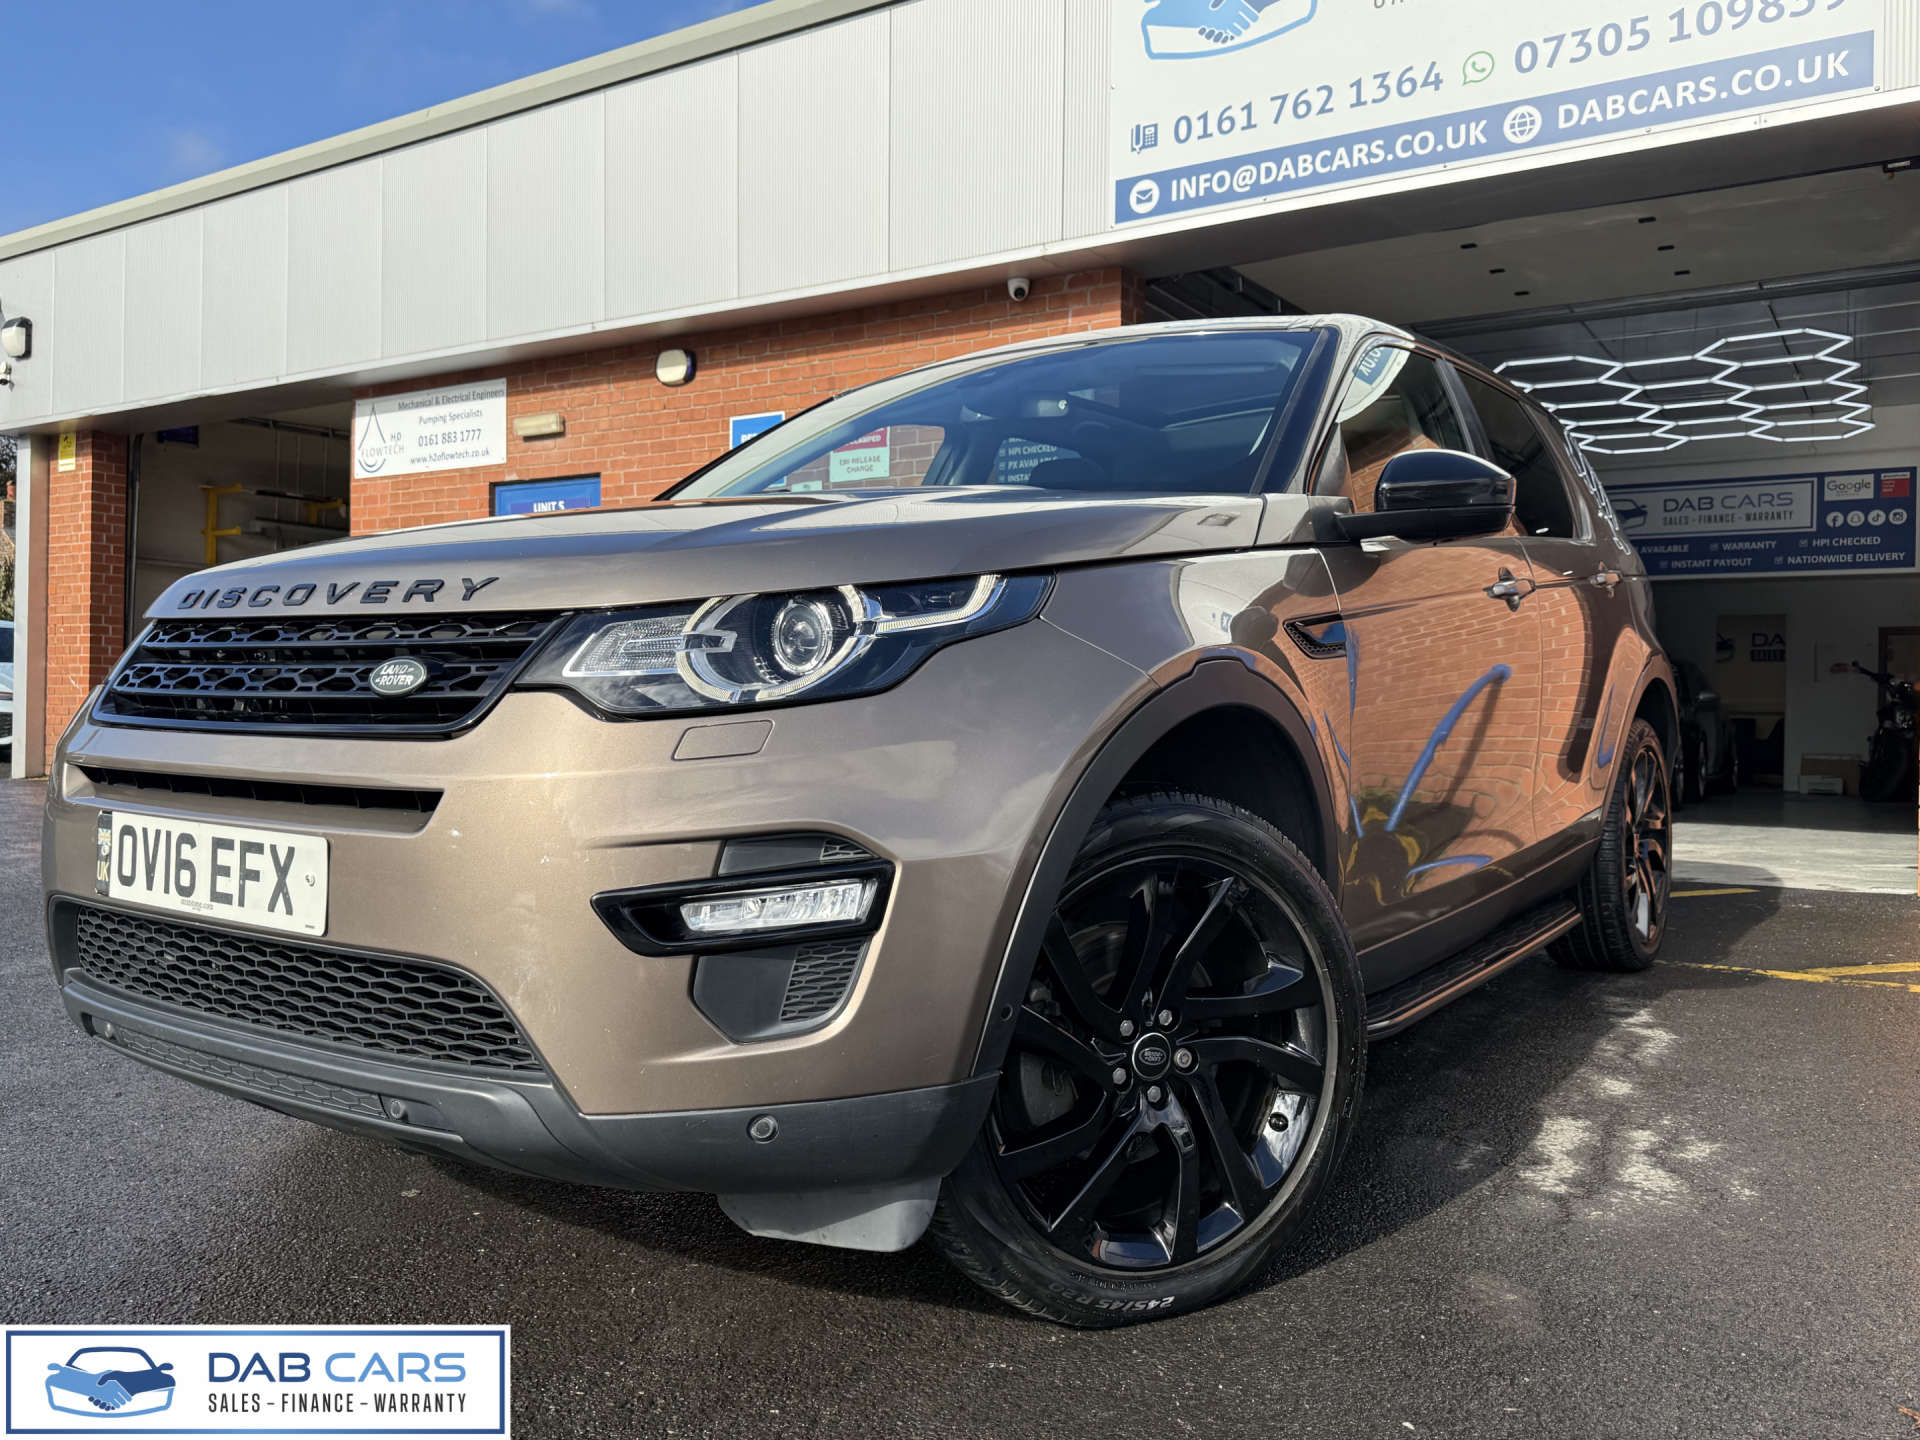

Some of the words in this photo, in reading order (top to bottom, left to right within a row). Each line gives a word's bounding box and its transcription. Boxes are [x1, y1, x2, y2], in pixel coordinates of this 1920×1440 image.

[1513, 16, 1650, 75] 07305
[1668, 0, 1845, 43] 1098
[1557, 50, 1849, 130] DABCARS.CO.UK
[1172, 105, 1258, 146] 0161
[1269, 86, 1335, 125] 762
[1349, 61, 1444, 109] 1364
[1170, 119, 1489, 202] INFO@DABCARS.CO.UK
[418, 413, 448, 425] Pumping
[449, 409, 483, 421] Specialists
[418, 433, 439, 448] 0161
[441, 431, 458, 444] 883
[460, 428, 482, 442] 1777
[360, 444, 405, 459] FLOWTECH
[1826, 479, 1872, 493] Google
[532, 501, 557, 513] UNIT
[1663, 496, 1715, 512] DAB
[1721, 492, 1793, 509] CARS
[1663, 515, 1689, 526] SALES
[1698, 512, 1735, 525] FINANCE
[1745, 509, 1794, 523] WARRANTY
[1640, 543, 1689, 554] AVAILABLE
[1721, 541, 1777, 552] WARRANTY
[1812, 538, 1830, 547] HPI
[1832, 536, 1881, 547] CHECKED
[1671, 558, 1712, 569] INSTANT
[1713, 557, 1753, 568] PAYOUT
[1787, 553, 1854, 565] NATIONWIDE
[1855, 551, 1906, 563] DELIVERY
[177, 576, 500, 610] DISCOVERY
[380, 664, 409, 675] LAND
[379, 674, 415, 686] ROVER
[96, 859, 110, 882] UK
[117, 824, 198, 898] OV16
[209, 836, 296, 916] EFX
[1096, 1296, 1175, 1311] 245/45
